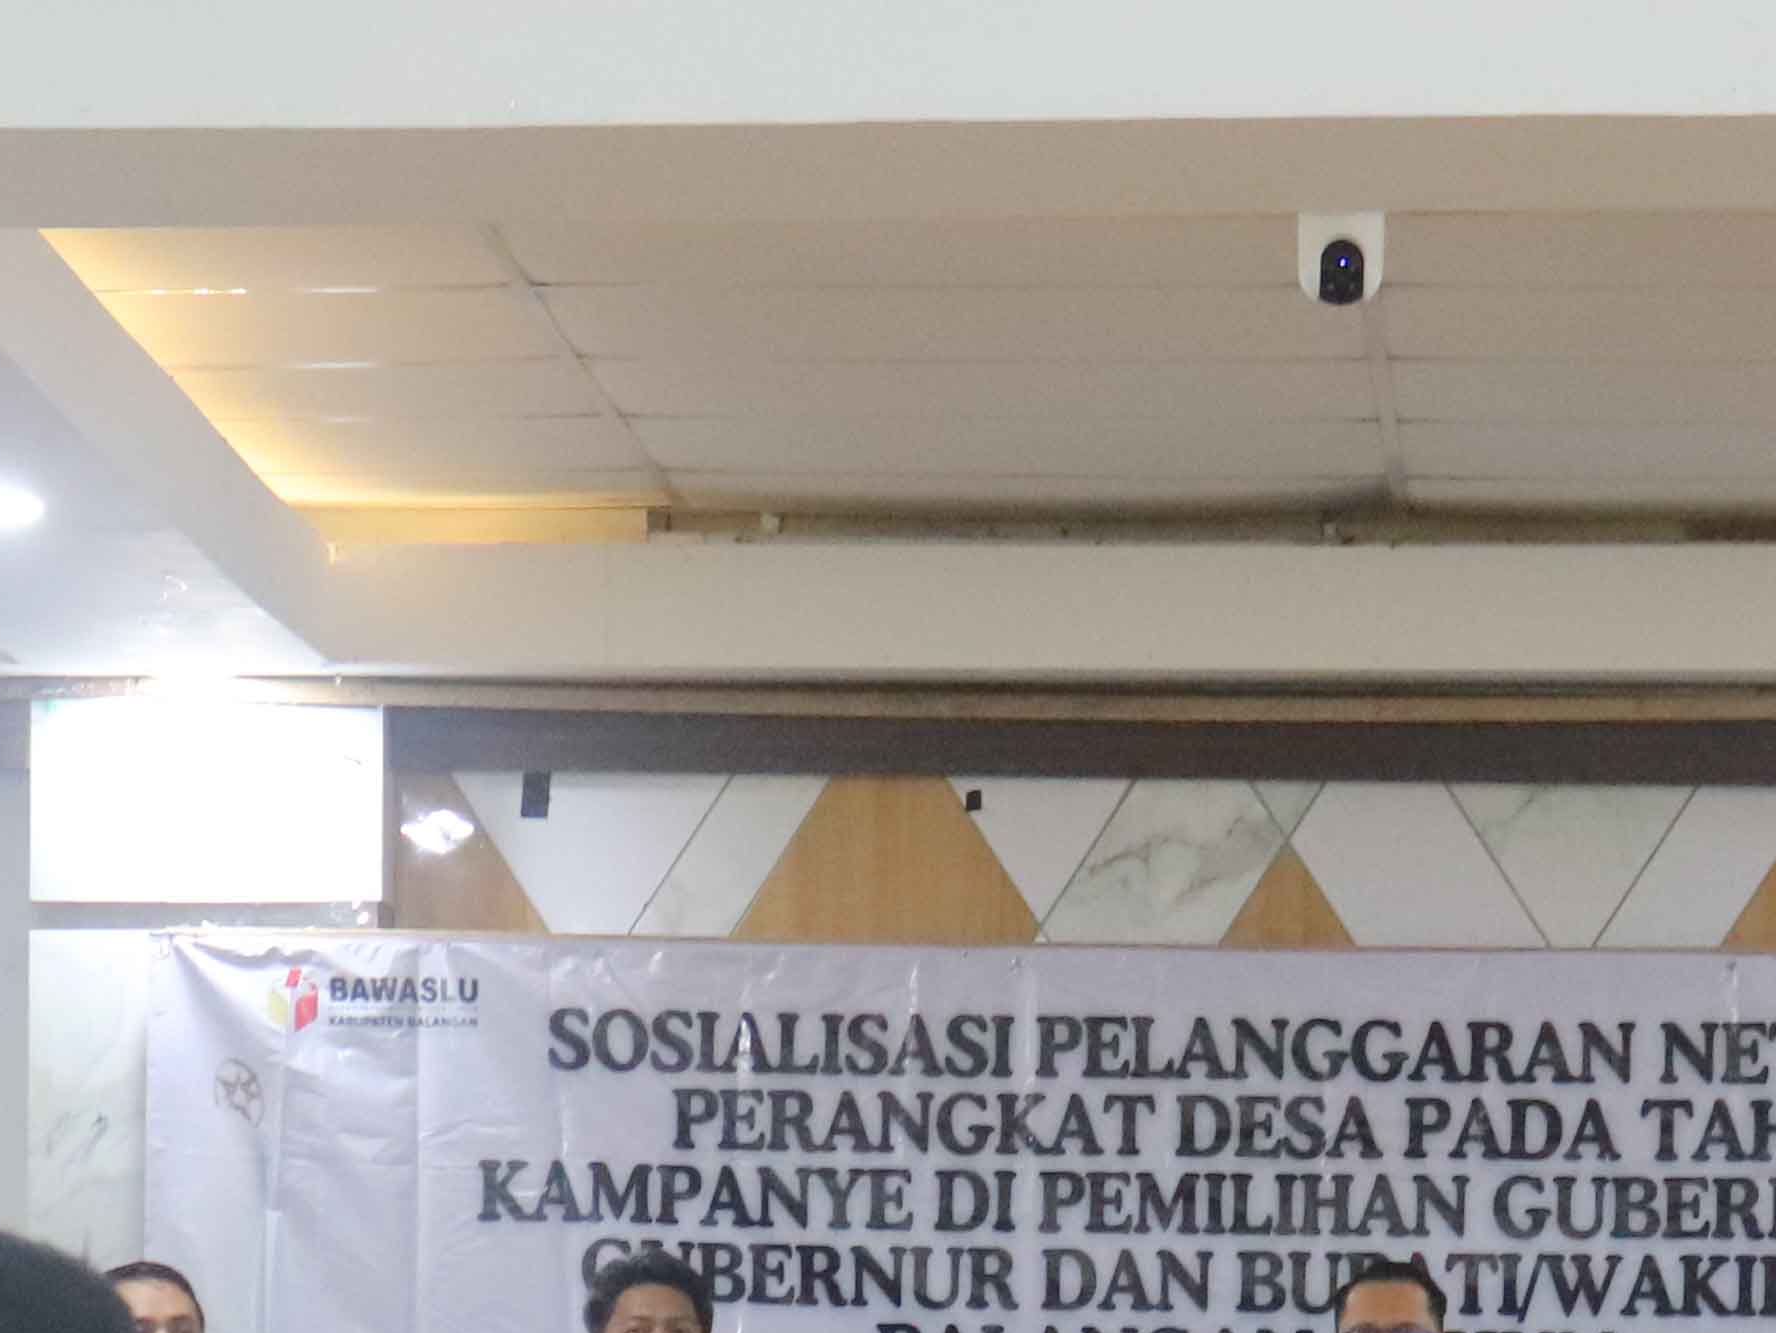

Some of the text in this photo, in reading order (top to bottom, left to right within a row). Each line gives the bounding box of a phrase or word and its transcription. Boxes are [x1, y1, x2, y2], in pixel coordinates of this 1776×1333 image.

[329, 977, 479, 1003] BAWASLU
[548, 1008, 1014, 1077] SOSIALISASI
[1036, 1015, 1635, 1084] PELANGGARAN
[673, 1088, 1156, 1155] PERANGKAT
[1175, 1095, 1383, 1159] DESA
[1403, 1097, 1621, 1161] PADA
[477, 1159, 914, 1230] KAMPANYE
[934, 1169, 1016, 1231] DI
[1038, 1170, 1470, 1237] PEMILIHAN
[581, 1238, 1020, 1310] GBERNUR
[1040, 1248, 1214, 1312] DAN
